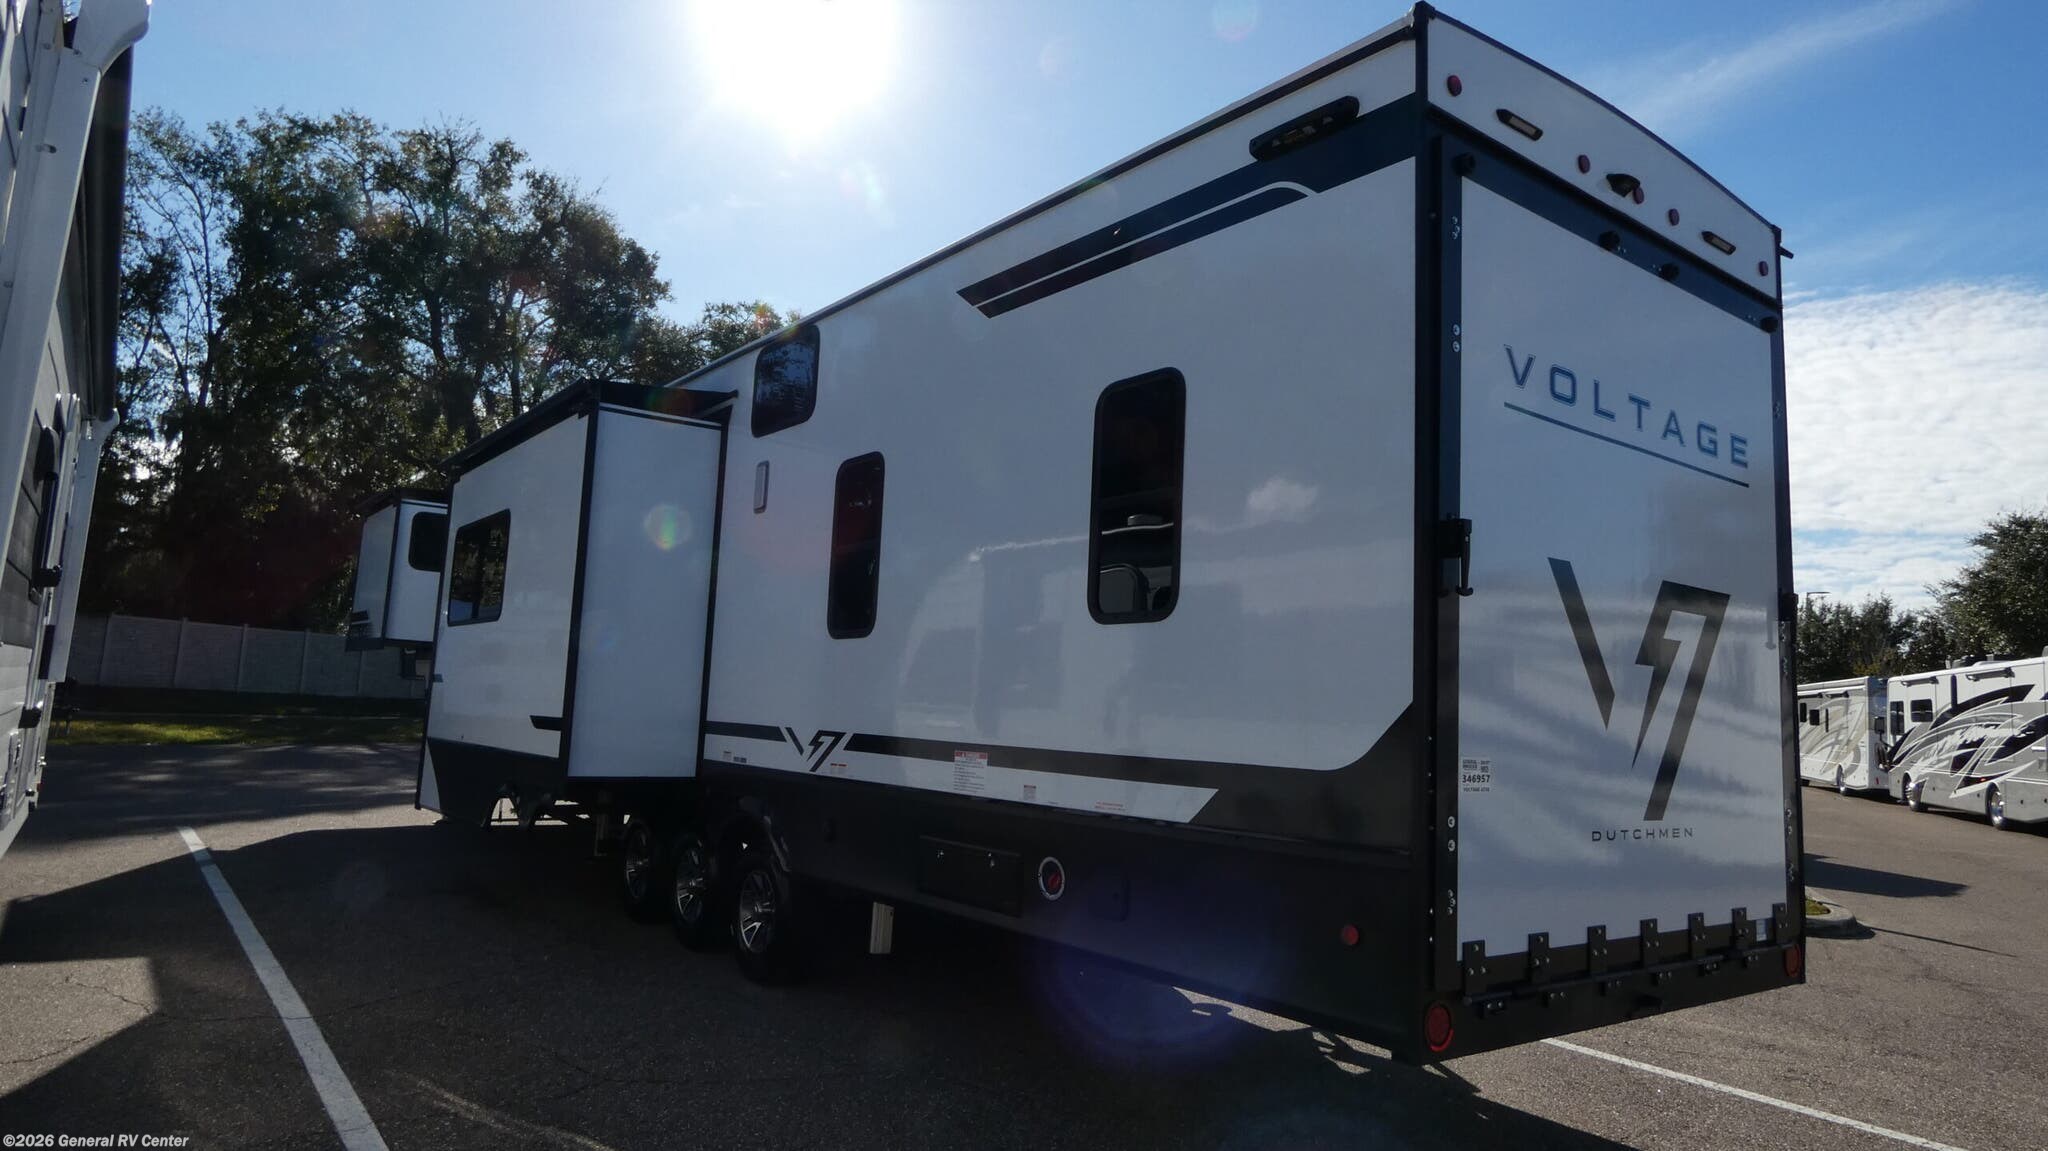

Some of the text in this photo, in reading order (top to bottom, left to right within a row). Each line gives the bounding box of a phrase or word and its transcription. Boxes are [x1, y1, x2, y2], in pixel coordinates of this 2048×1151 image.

[1504, 344, 1749, 469] VOLTAGE
[1462, 774, 1490, 783] 346957
[1591, 827, 1694, 842] DUTCHMEN
